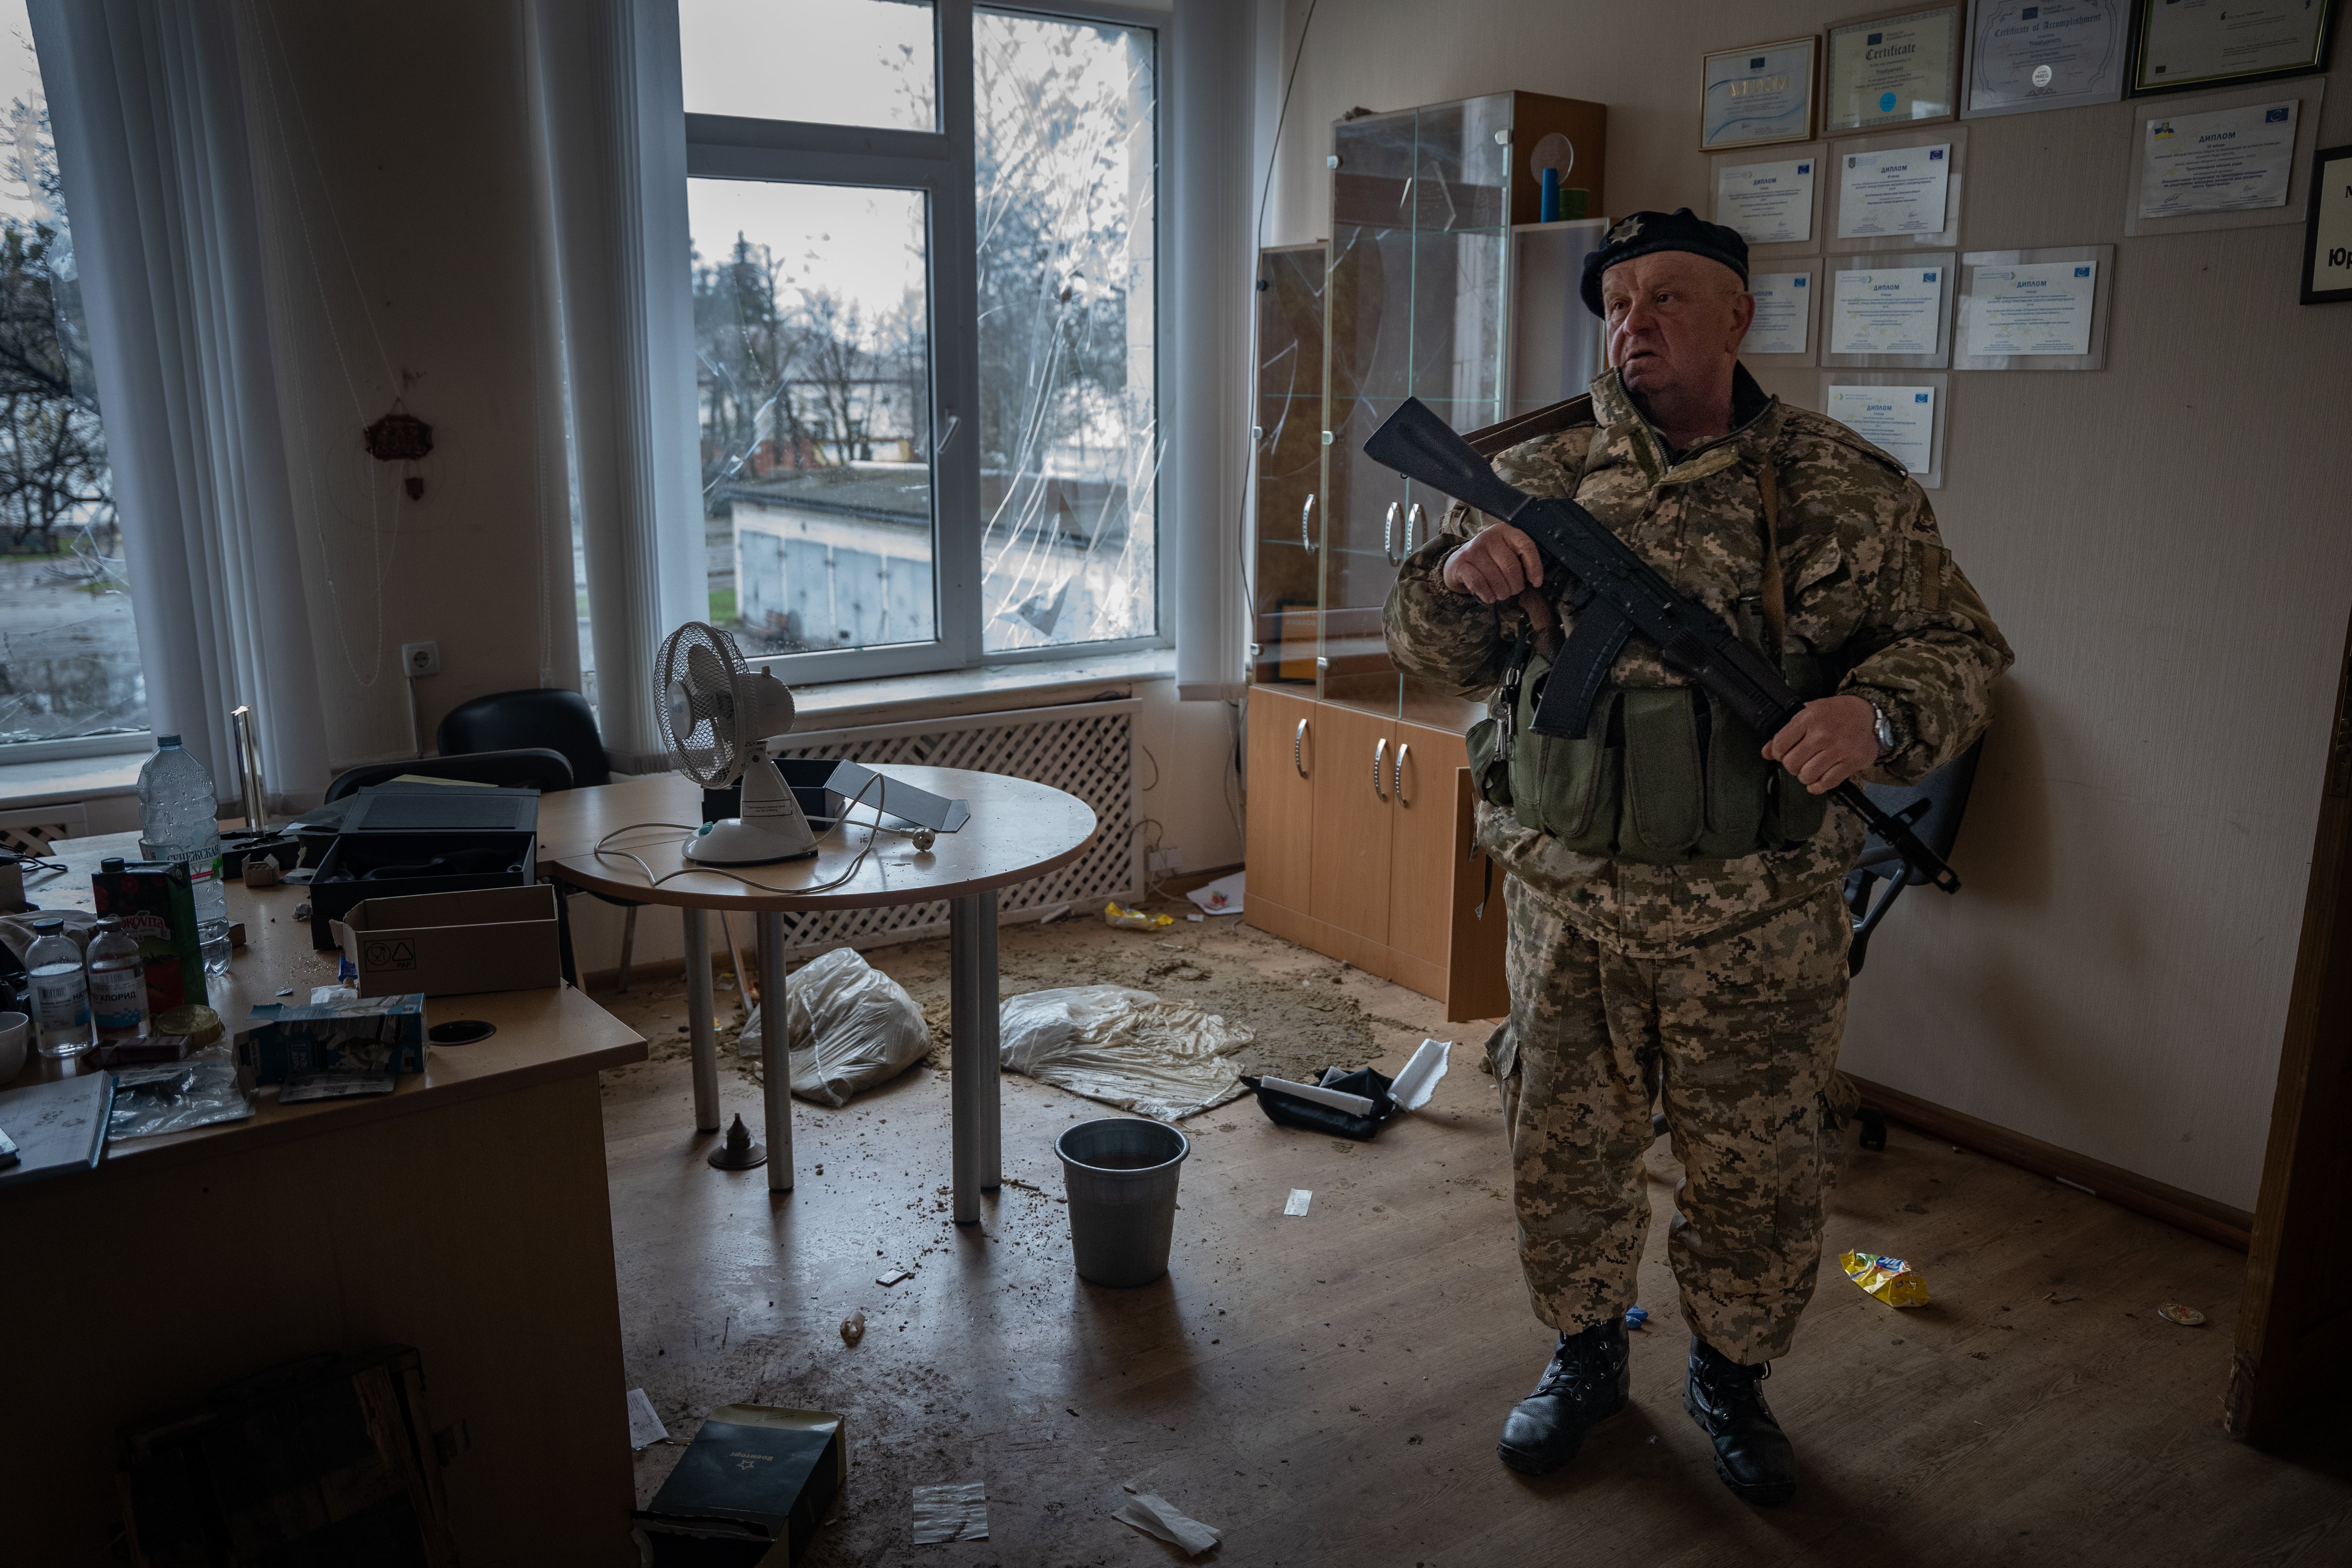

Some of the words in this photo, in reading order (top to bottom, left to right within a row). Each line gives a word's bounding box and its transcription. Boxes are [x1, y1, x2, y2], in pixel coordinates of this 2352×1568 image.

[1994, 26, 2029, 38] Certificate
[2033, 23, 2040, 31] of
[2043, 13, 2102, 30] Accomplishment
[2029, 38, 2061, 46] Trostyanets
[1866, 44, 1916, 60] Certificate
[1875, 66, 1903, 74] Trostyanets
[1727, 75, 1790, 97] ДИПЛОМ
[2199, 132, 2236, 143] ДИПЛОМ
[1881, 165, 1907, 173] ДИПЛОМ
[1753, 178, 1777, 186] ДИПЛОМ
[2017, 280, 2047, 289] ДИПЛОМ
[100, 991, 136, 1001] ХЛОРИД
[1878, 1256, 1902, 1269] TUC
[729, 1452, 774, 1461] Военторг
